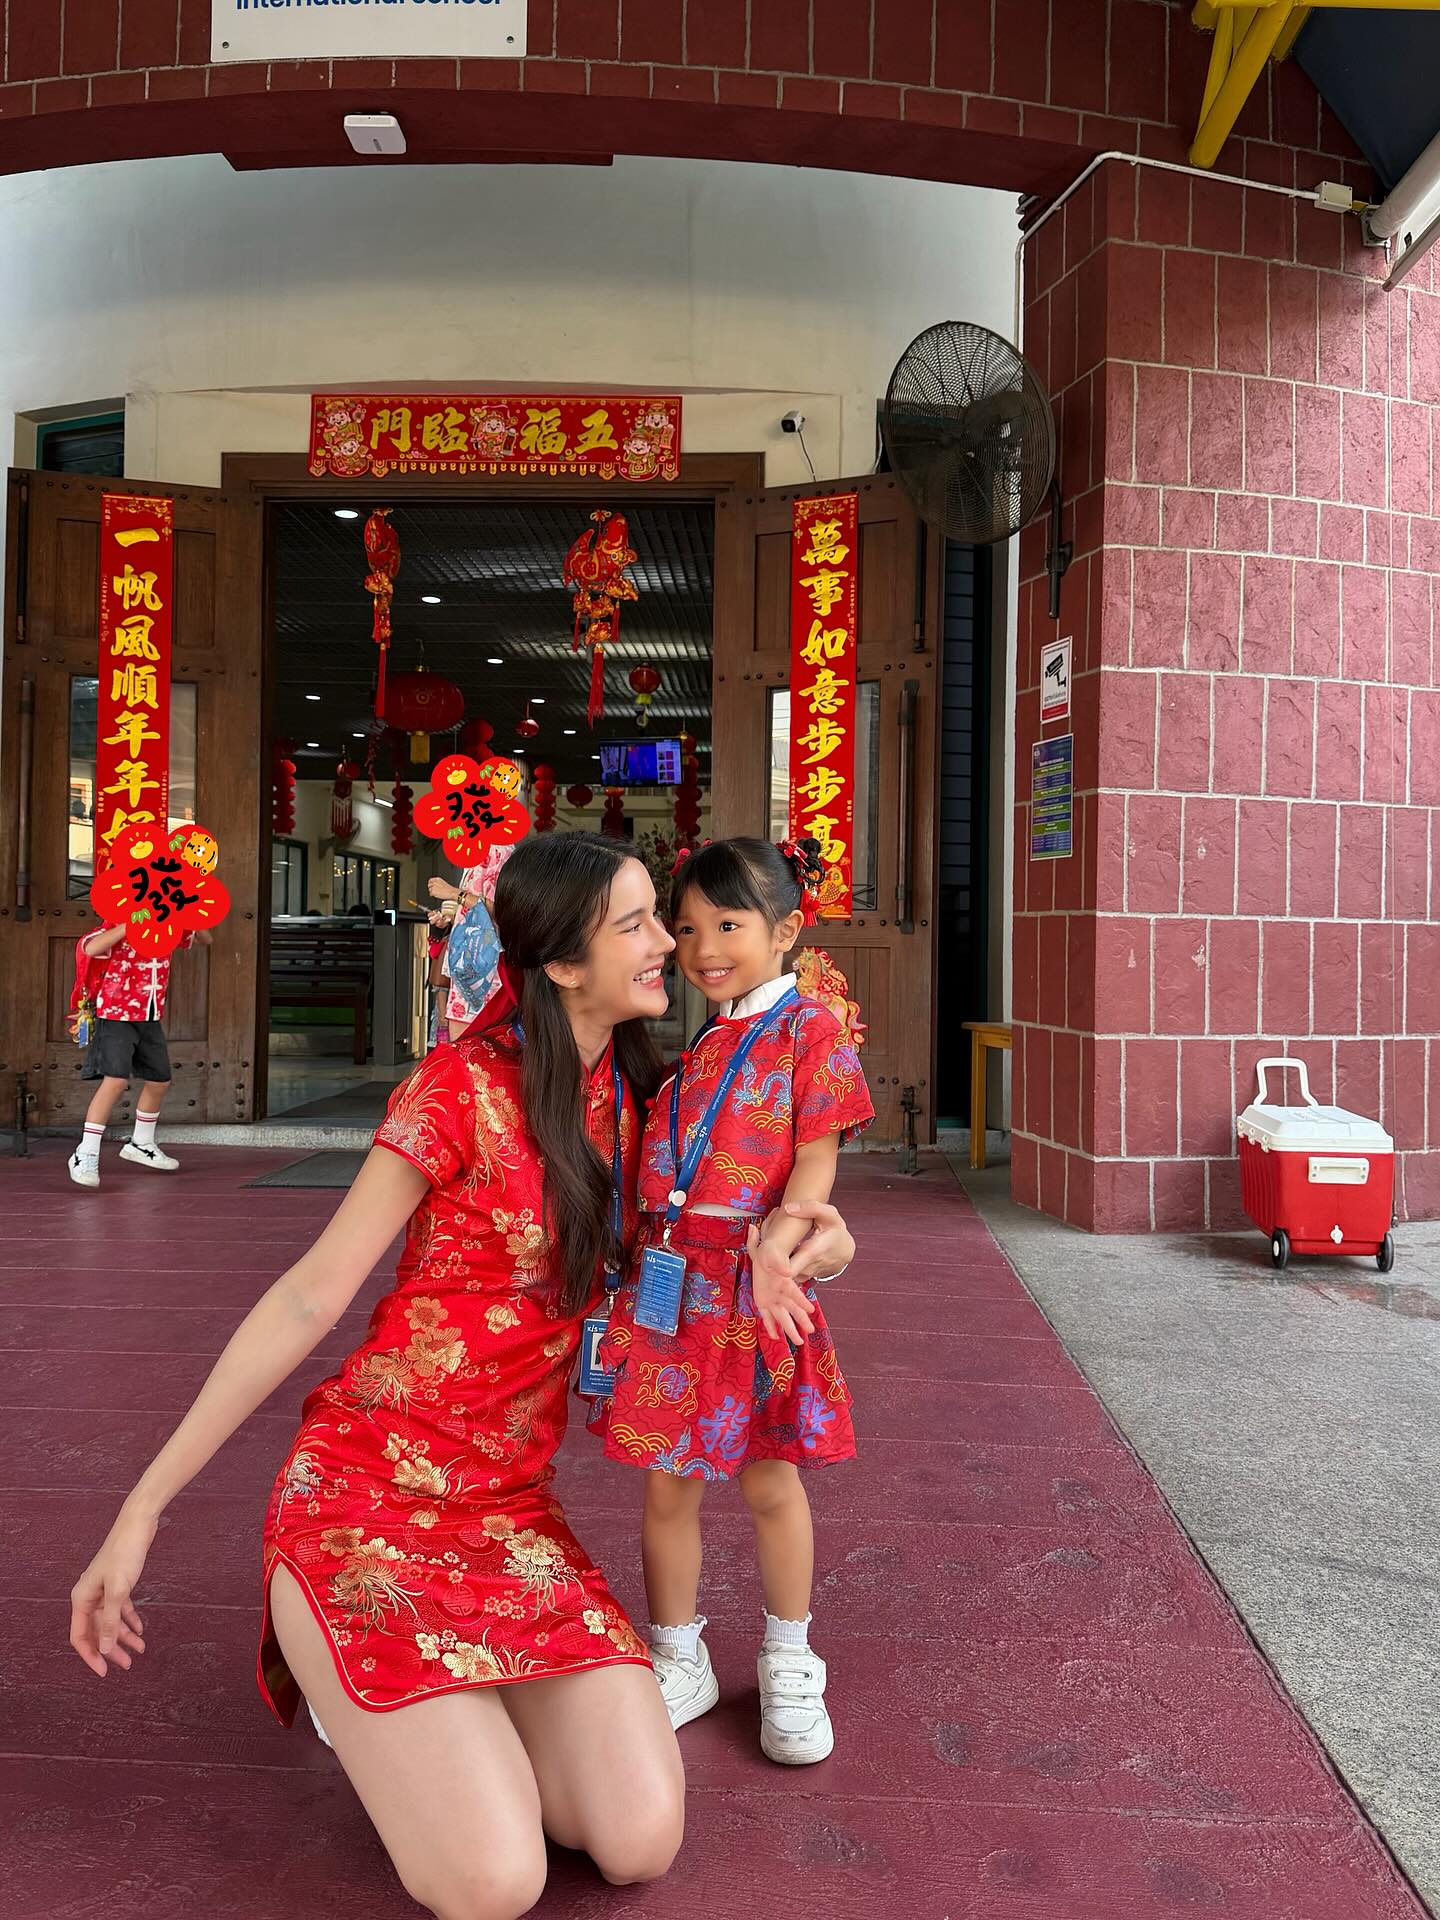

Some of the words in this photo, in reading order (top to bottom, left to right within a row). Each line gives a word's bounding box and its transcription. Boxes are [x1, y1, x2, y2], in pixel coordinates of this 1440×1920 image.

[796, 519, 850, 864] 萬事如意步步高
